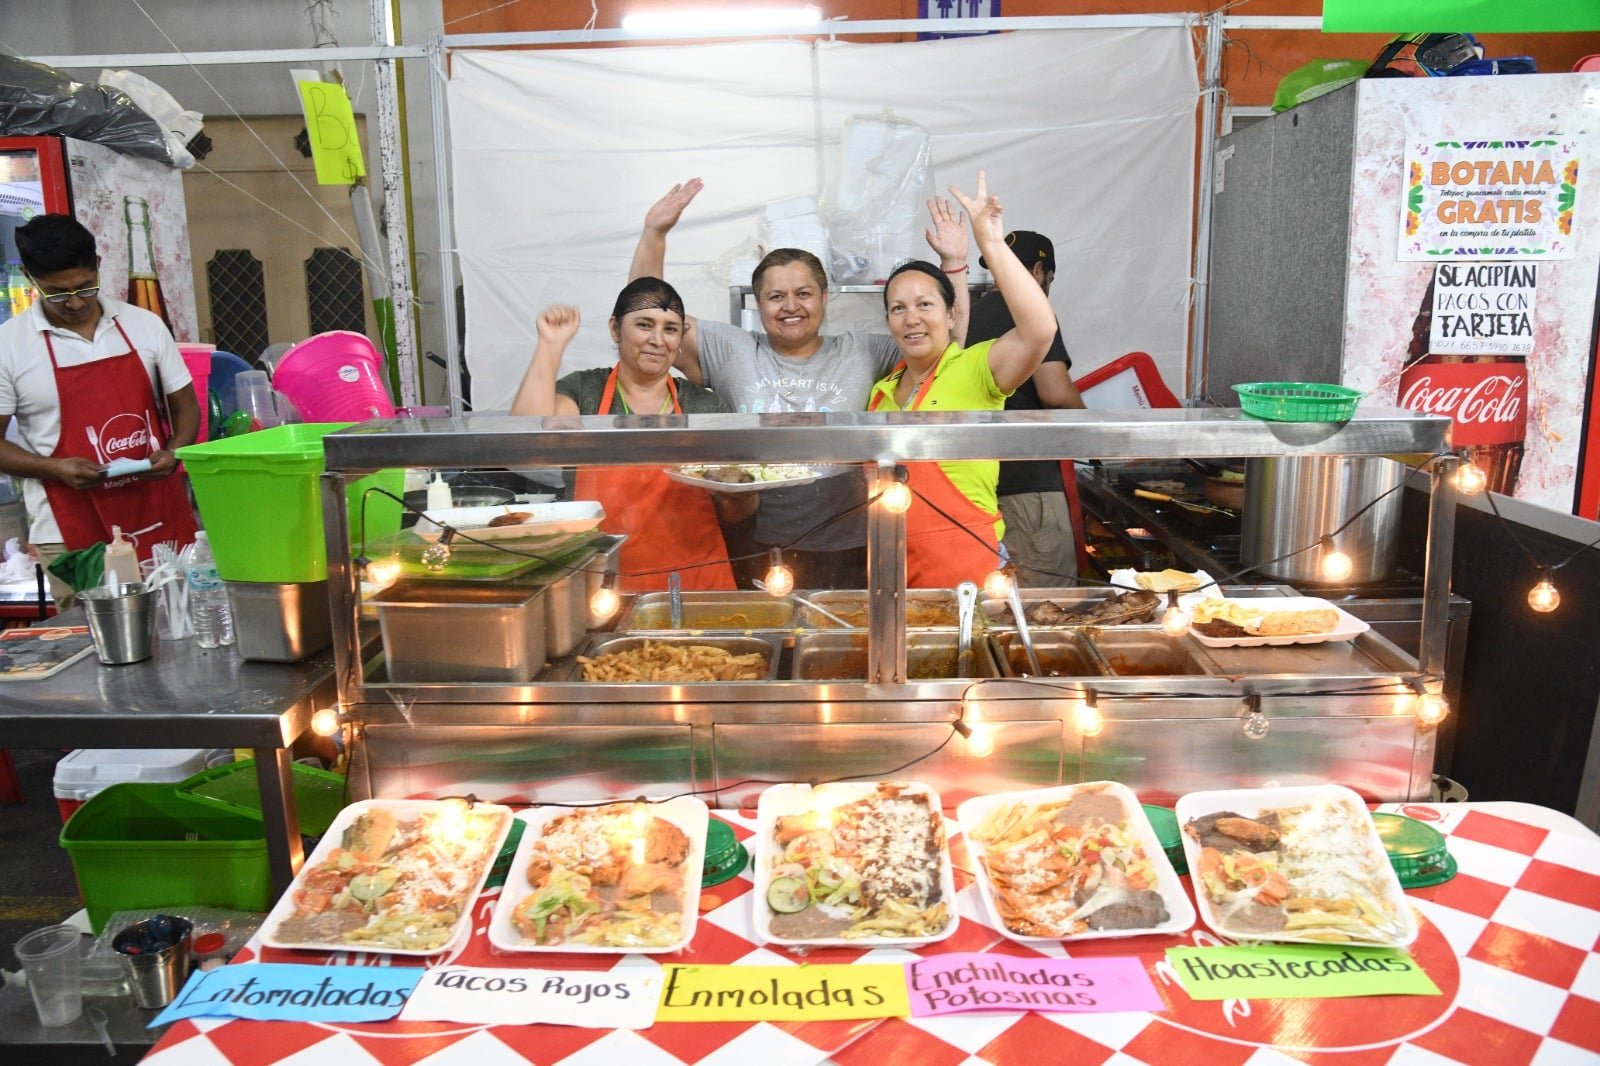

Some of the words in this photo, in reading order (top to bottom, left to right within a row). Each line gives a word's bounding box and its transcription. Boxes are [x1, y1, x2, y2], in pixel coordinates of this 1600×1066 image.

[1431, 159, 1556, 186] BOTANA
[1437, 199, 1542, 224] GRATIS
[1460, 230, 1488, 238] compra
[1490, 228, 1500, 236] de
[1501, 228, 1509, 236] tu
[1438, 293, 1490, 310] PAGOS
[1496, 293, 1528, 310] CON
[1437, 311, 1532, 337] TARJETA
[773, 378, 815, 389] HEART
[816, 381, 827, 391] IS
[830, 383, 843, 395] IN
[1401, 375, 1524, 424] Coca-Cola
[106, 429, 147, 454] Coca-Cola
[433, 969, 528, 993] Tacos
[541, 976, 631, 1004] Rojos
[663, 967, 885, 1010] Enmoladas
[911, 960, 1095, 991] Enchiladas
[176, 969, 410, 1009] Entomatadas
[924, 986, 1097, 1010] Potosinas
